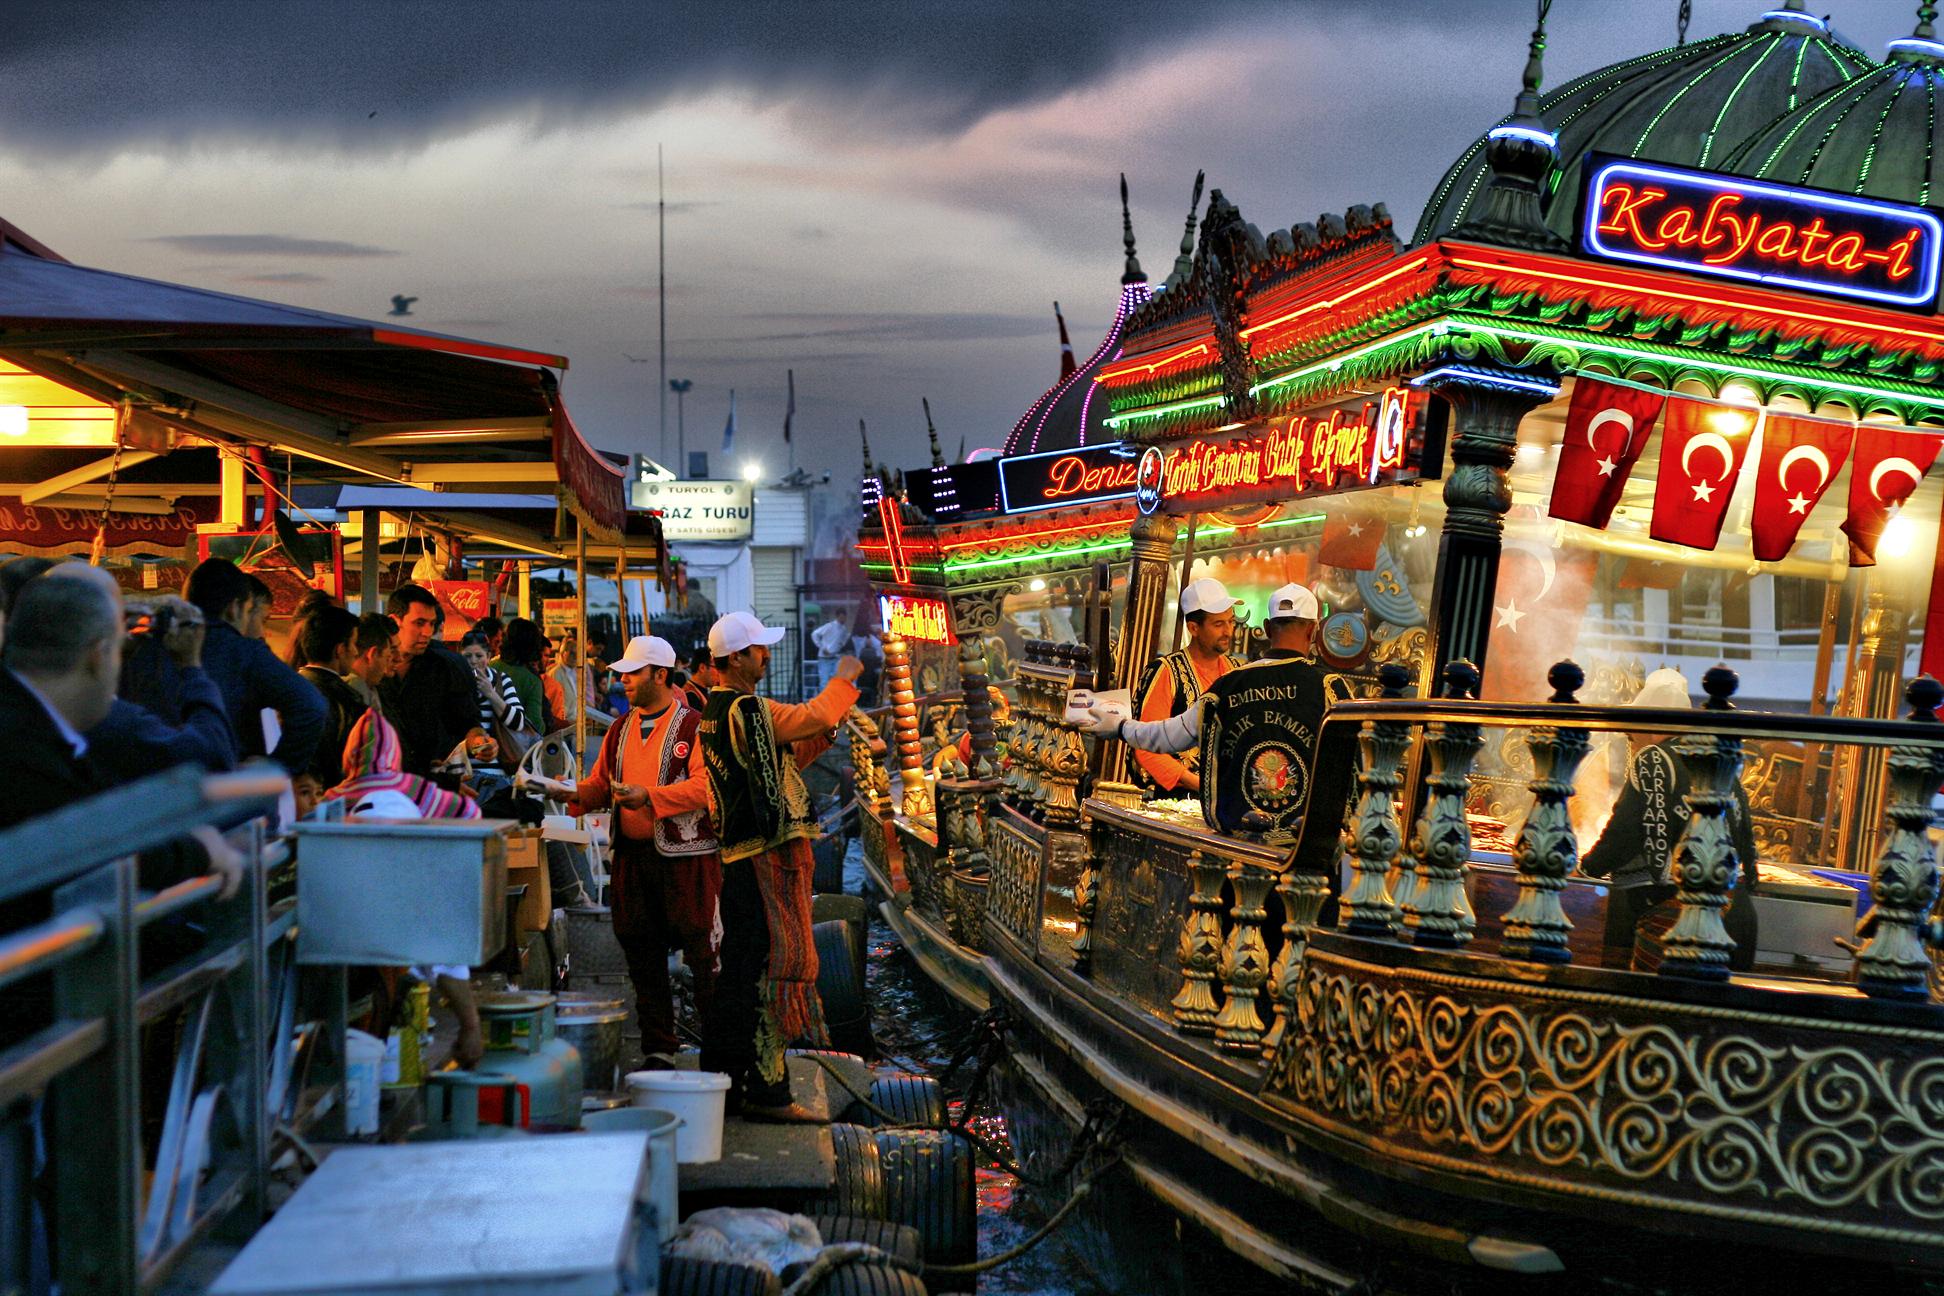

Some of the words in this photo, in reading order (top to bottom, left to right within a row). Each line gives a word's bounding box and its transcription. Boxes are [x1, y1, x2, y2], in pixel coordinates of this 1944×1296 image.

[1597, 184, 1922, 279] Kalyata-i
[667, 486, 716, 494] TURYOL
[1044, 456, 1139, 497] Deniz
[660, 504, 692, 519] ĞAZ
[702, 506, 749, 519] TURU
[1263, 710, 1317, 749] EKMEK
[751, 712, 780, 810] BARBAROS
[1651, 750, 1668, 868] BARBAROS
